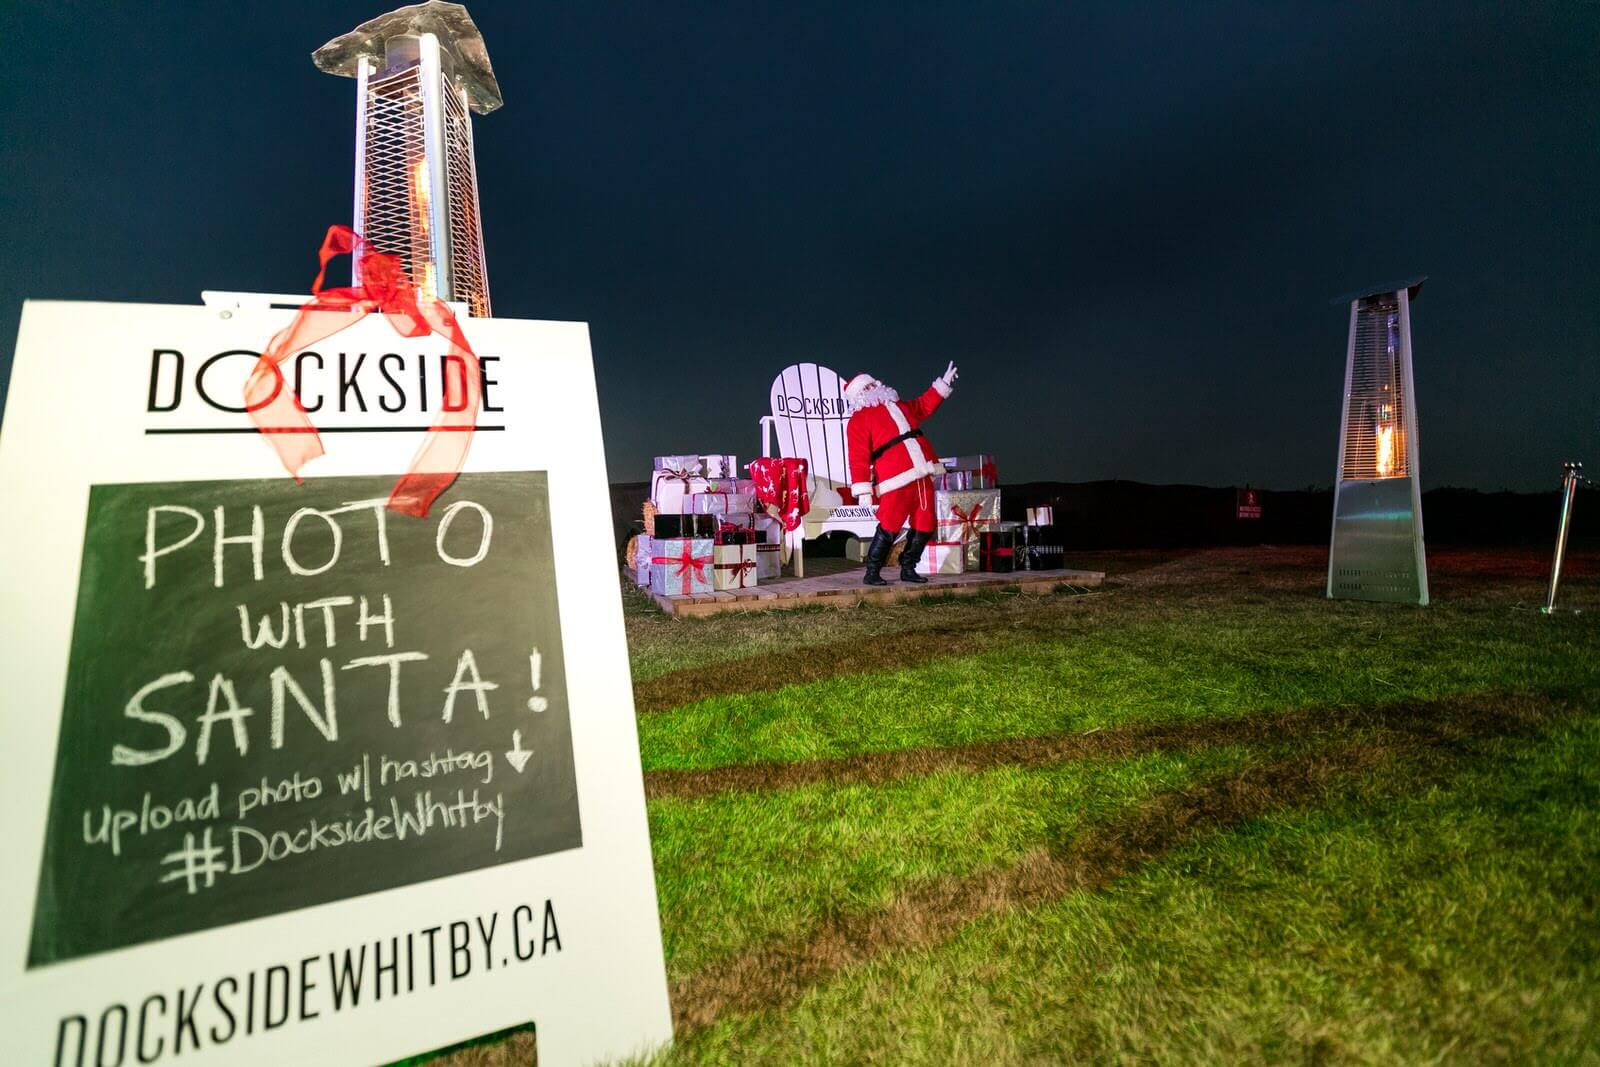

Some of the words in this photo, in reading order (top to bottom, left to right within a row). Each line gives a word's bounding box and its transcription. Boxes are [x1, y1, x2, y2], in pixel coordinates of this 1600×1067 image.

[146, 349, 504, 413] DOCKSIDE
[138, 496, 494, 590] PHOTO
[236, 593, 395, 649] WITH
[110, 647, 549, 767] SANTA!
[82, 783, 220, 856] Upload
[238, 770, 323, 819] photo
[337, 753, 371, 802] w/
[379, 748, 494, 785] hashtag
[158, 789, 506, 894] #DocksideWhitby
[54, 899, 562, 1067] DOCKSIDEWHITBY.CA
